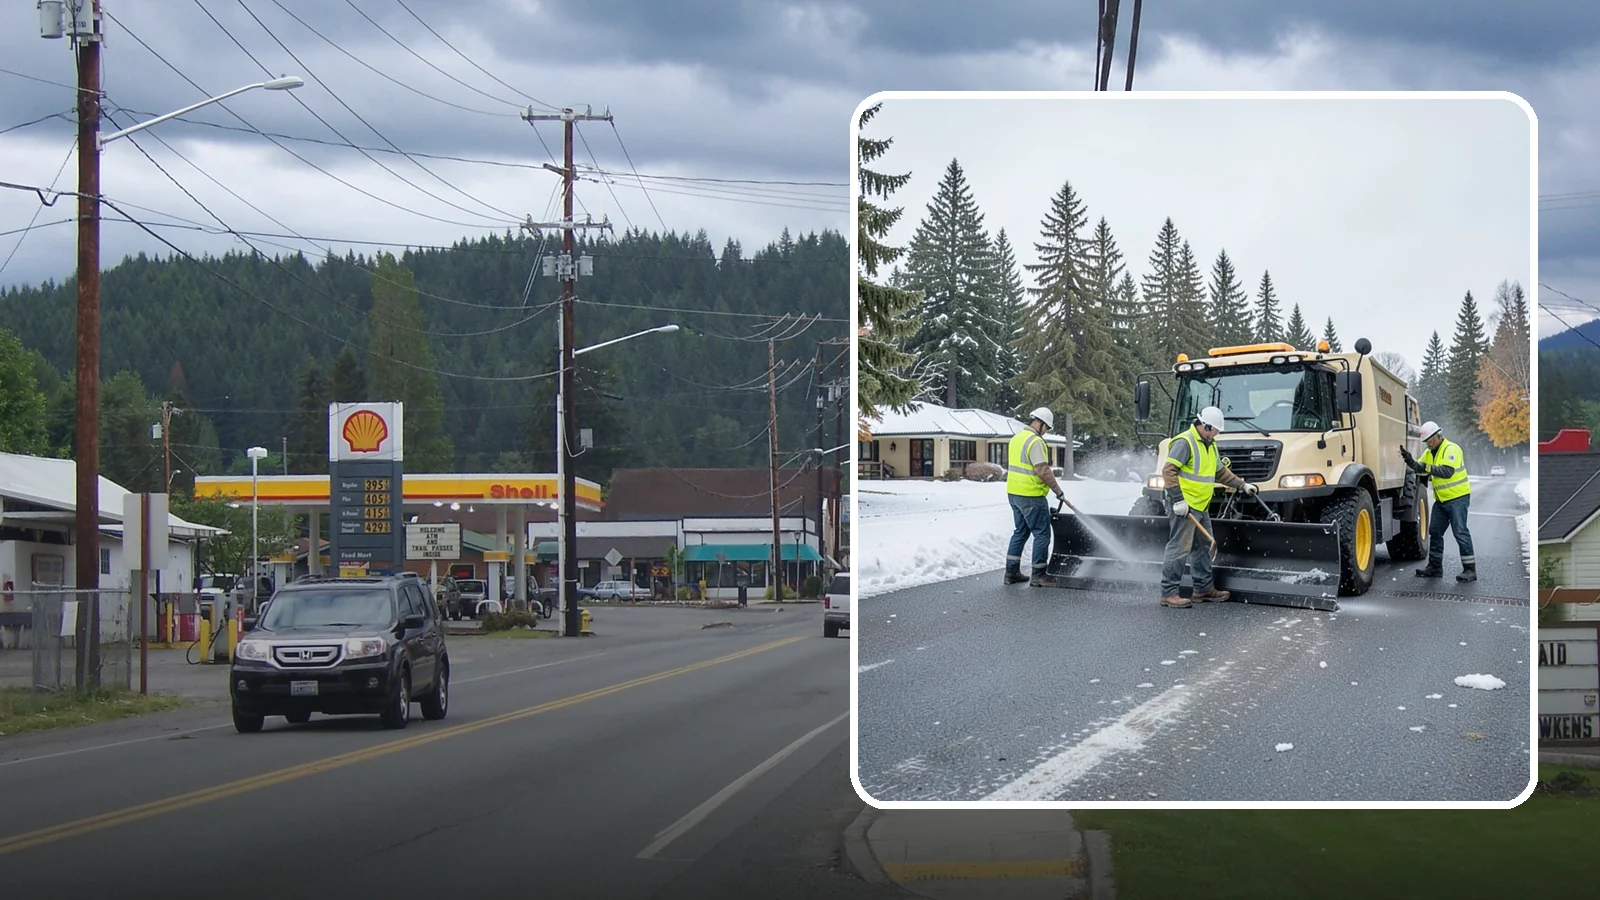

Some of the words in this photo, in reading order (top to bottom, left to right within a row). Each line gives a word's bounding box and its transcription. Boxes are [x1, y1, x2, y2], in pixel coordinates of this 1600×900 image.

[366, 480, 384, 490] 395
[490, 484, 547, 499] Shell
[366, 494, 384, 504] 405
[366, 508, 384, 518] 415
[366, 522, 384, 532] 429
[1539, 643, 1566, 665] AID
[1538, 716, 1592, 738] WKENS
